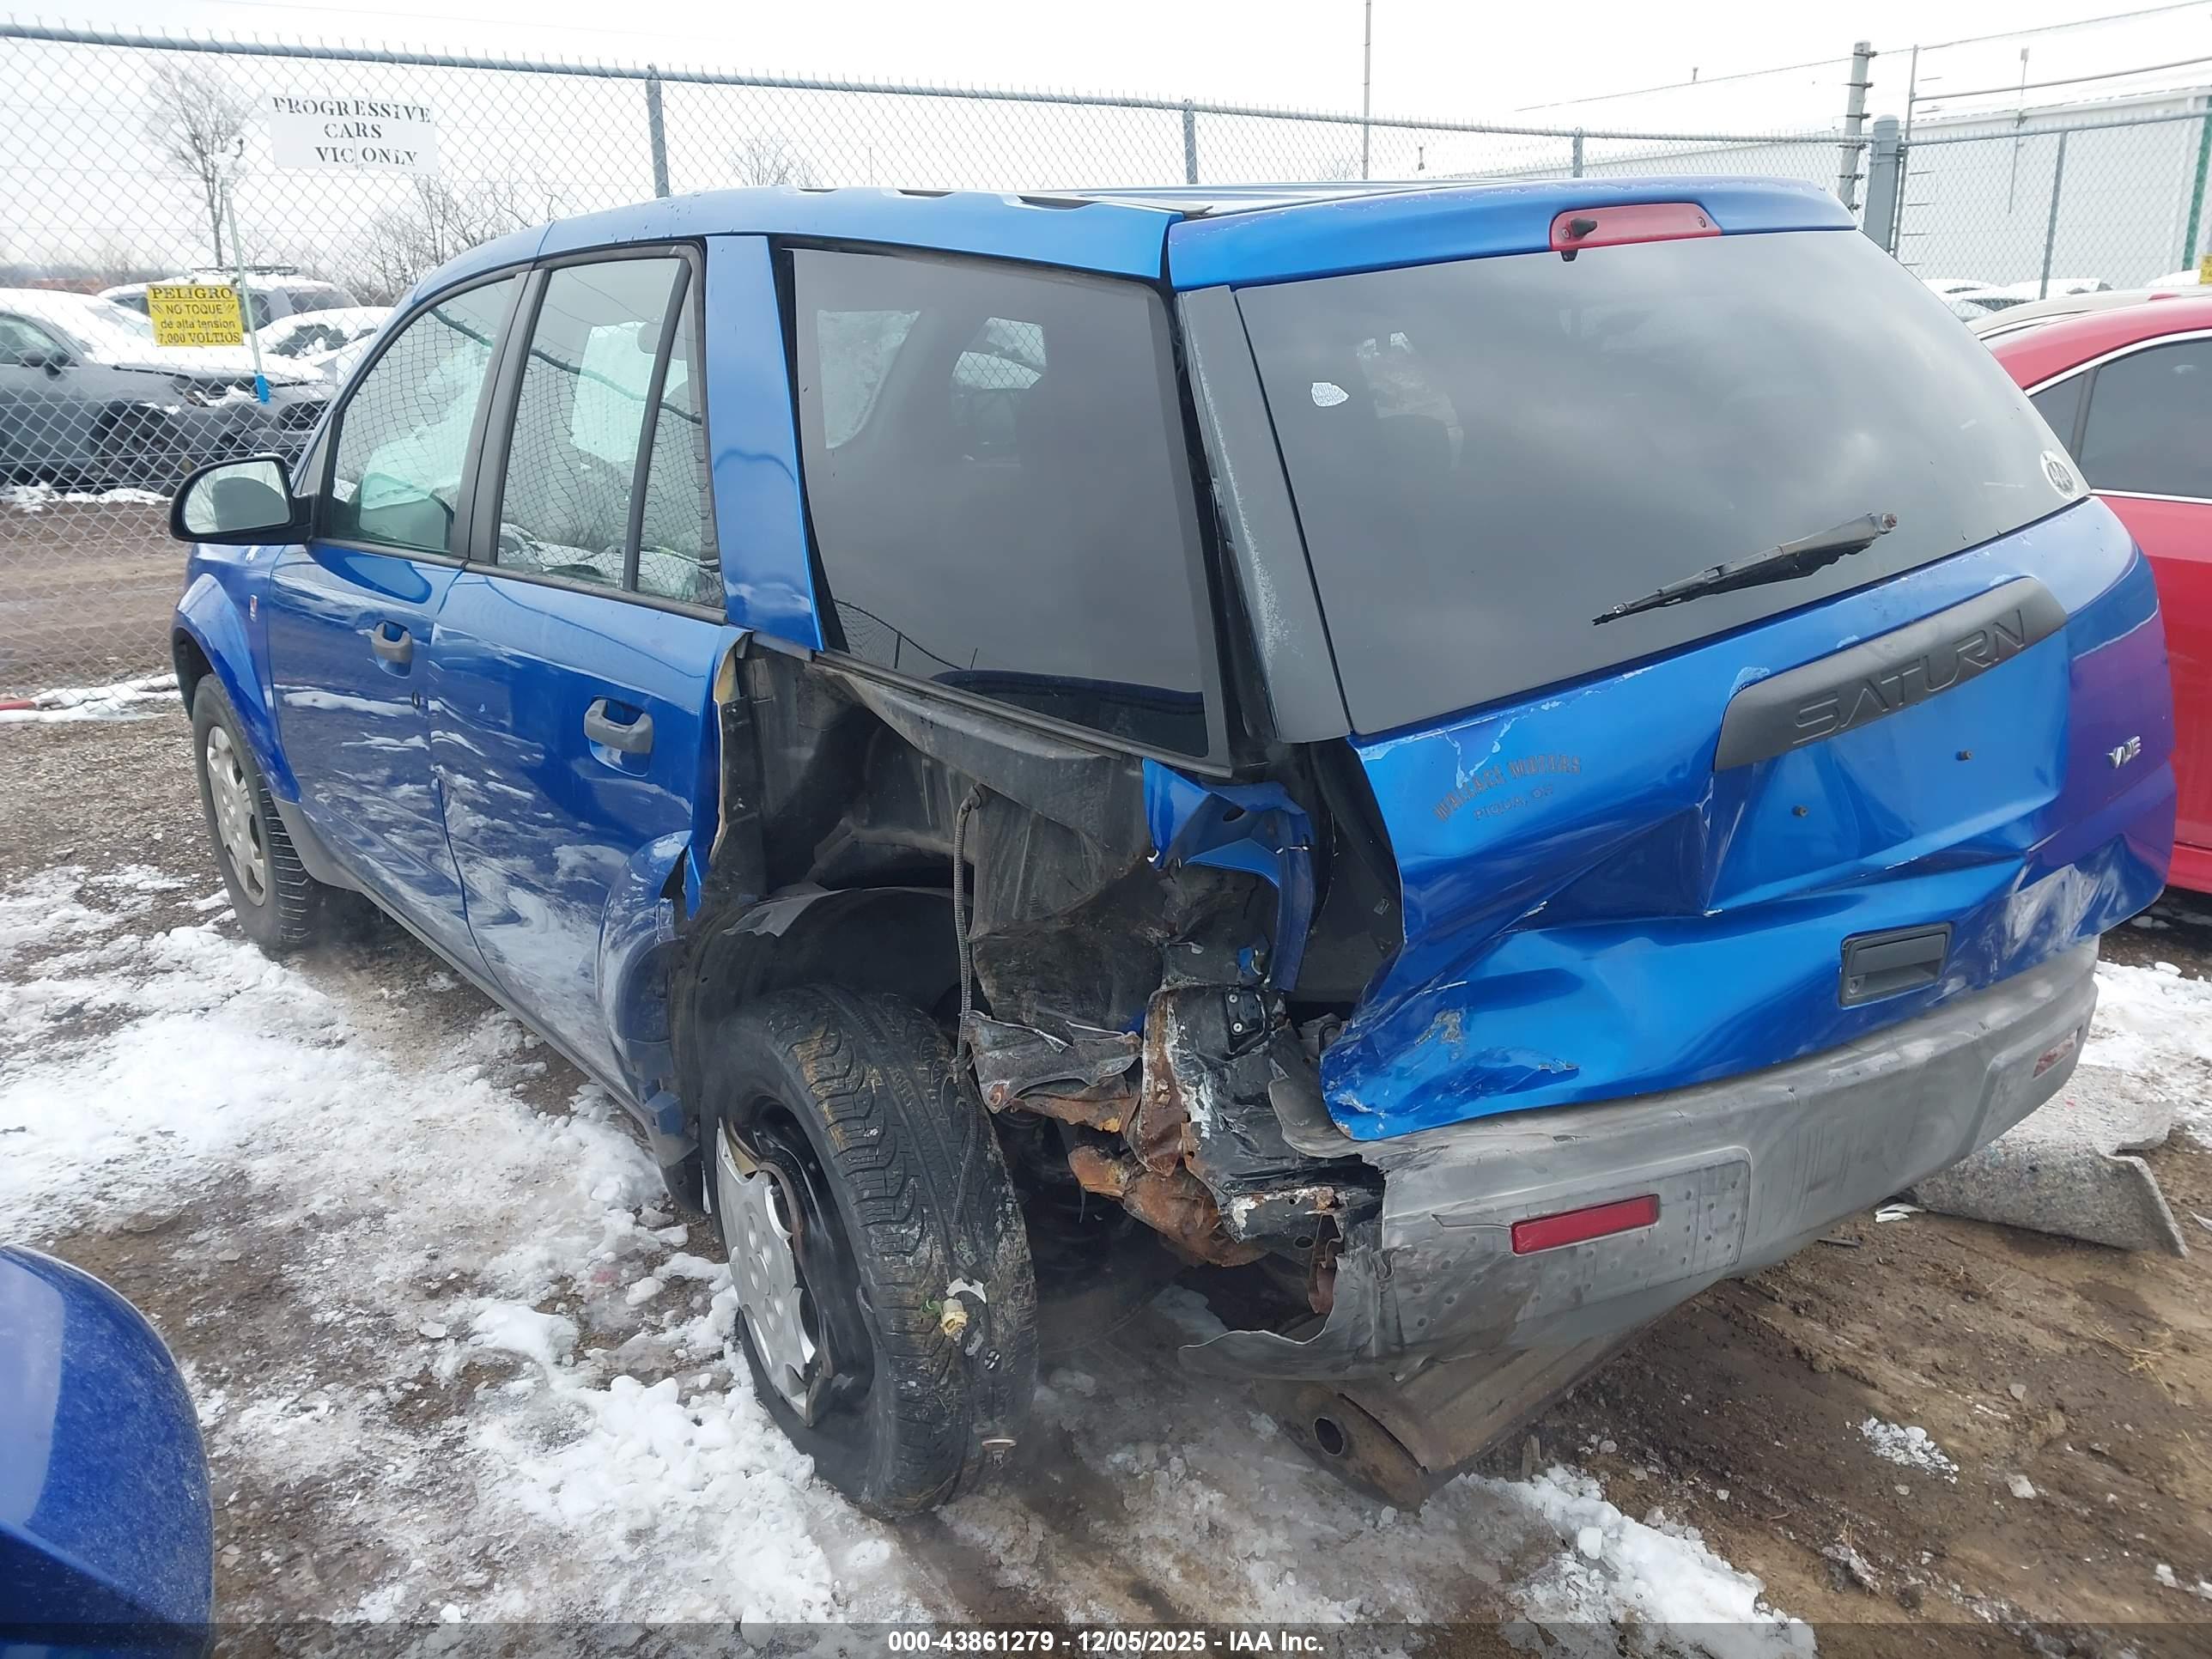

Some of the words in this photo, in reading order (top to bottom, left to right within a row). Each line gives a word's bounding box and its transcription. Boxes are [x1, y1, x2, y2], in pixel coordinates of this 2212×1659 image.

[272, 96, 431, 123] PROGRESSIVE
[324, 122, 382, 138] CARS
[314, 146, 355, 163] VIC
[362, 147, 417, 167] ONLY
[152, 287, 233, 300] PELIGRO
[166, 304, 182, 315] NO
[185, 304, 223, 315] TOQUE
[161, 319, 173, 329] de
[176, 319, 195, 329] alta
[198, 319, 235, 329] tension
[188, 331, 241, 343] VOLTIOS
[1792, 607, 2026, 745] SATURN
[2106, 735, 2142, 769] VUE
